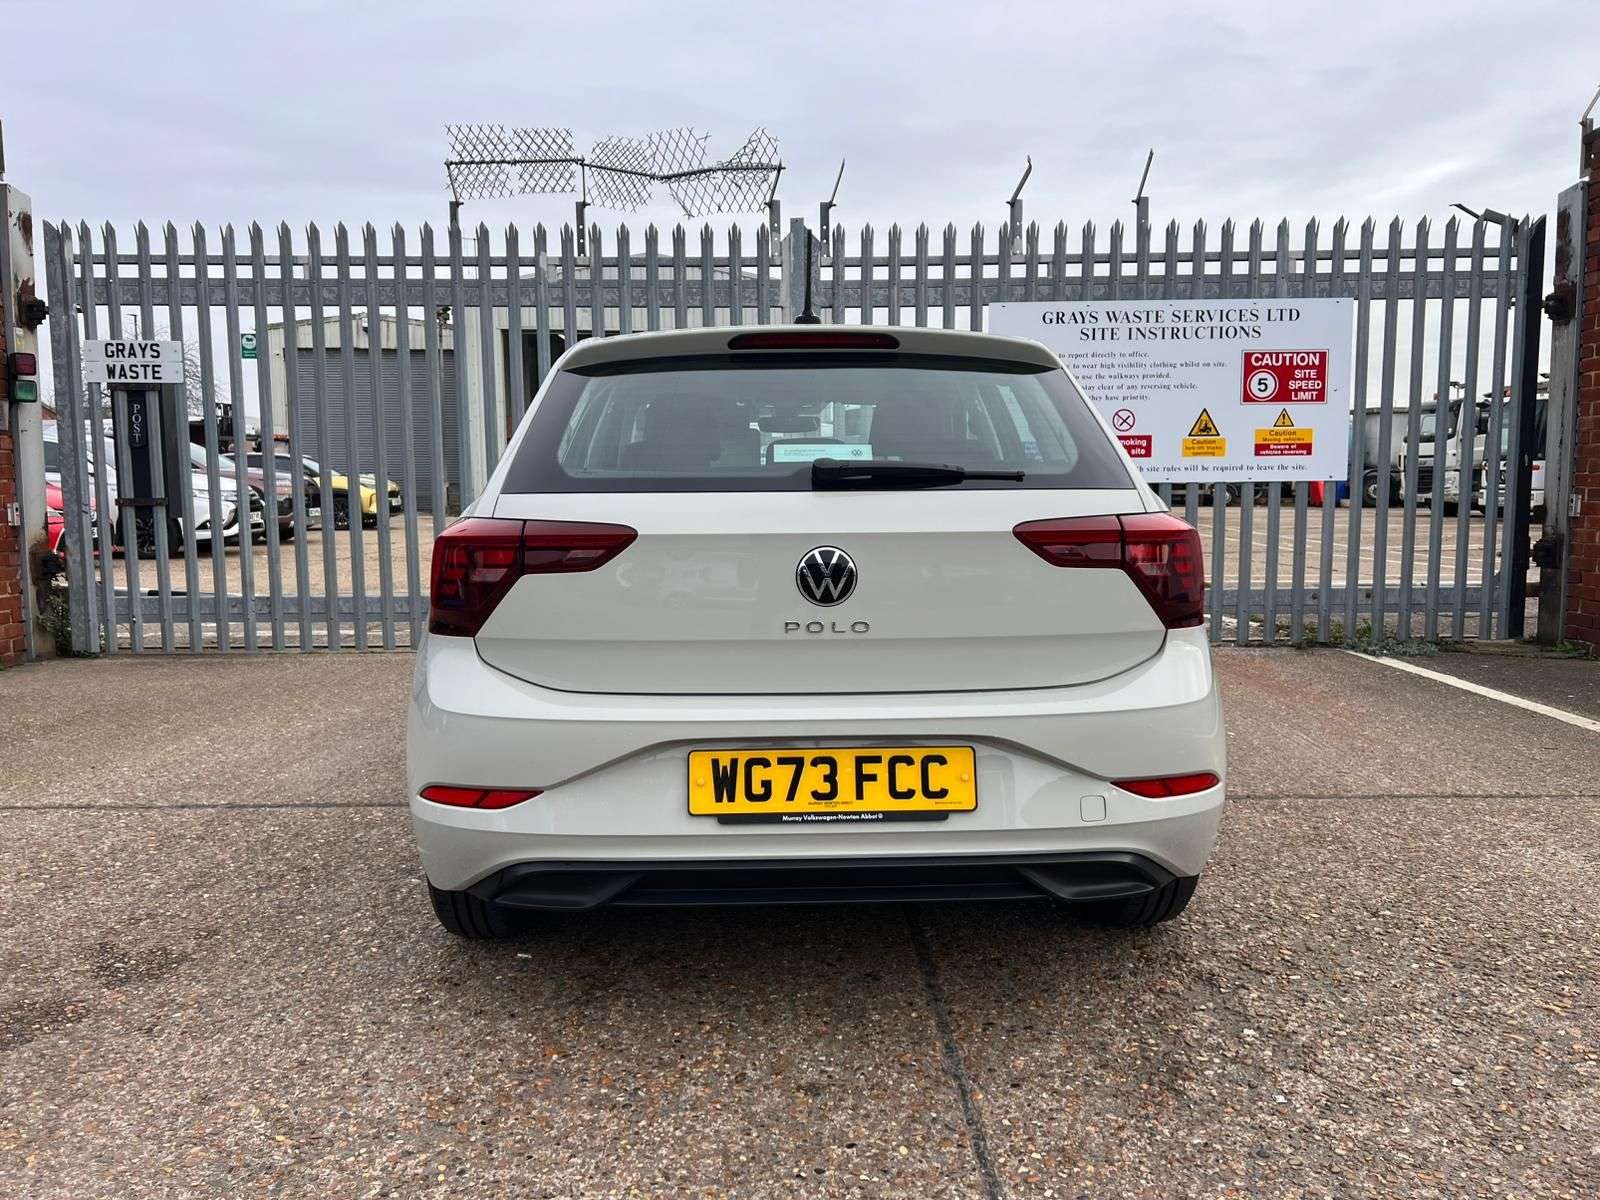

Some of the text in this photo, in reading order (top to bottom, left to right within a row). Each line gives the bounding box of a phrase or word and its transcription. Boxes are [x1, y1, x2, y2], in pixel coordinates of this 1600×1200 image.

[1042, 307, 1300, 325] GRAYS WASTE SERVICES LTD
[1080, 325, 1261, 341] SITE INSTRUCTIONS
[104, 342, 160, 359] GRAYS
[1068, 352, 1088, 360] report
[1091, 351, 1116, 359] directly
[1100, 362, 1115, 371] high
[1118, 361, 1147, 370] visibility
[1150, 361, 1177, 369] clothing
[1251, 353, 1320, 367] CAUTION
[106, 364, 162, 380] WASTE
[1108, 372, 1139, 381] walkways
[1294, 369, 1317, 379] SITE
[1257, 378, 1268, 392] 5
[1288, 379, 1322, 390] SPEED
[1291, 391, 1318, 401] LIMIT
[132, 404, 141, 443] POST
[1120, 438, 1147, 447] moking
[1131, 447, 1146, 455] site
[1212, 464, 1244, 472] required
[784, 621, 870, 634] POLO
[711, 754, 950, 803] WG73 FCC
